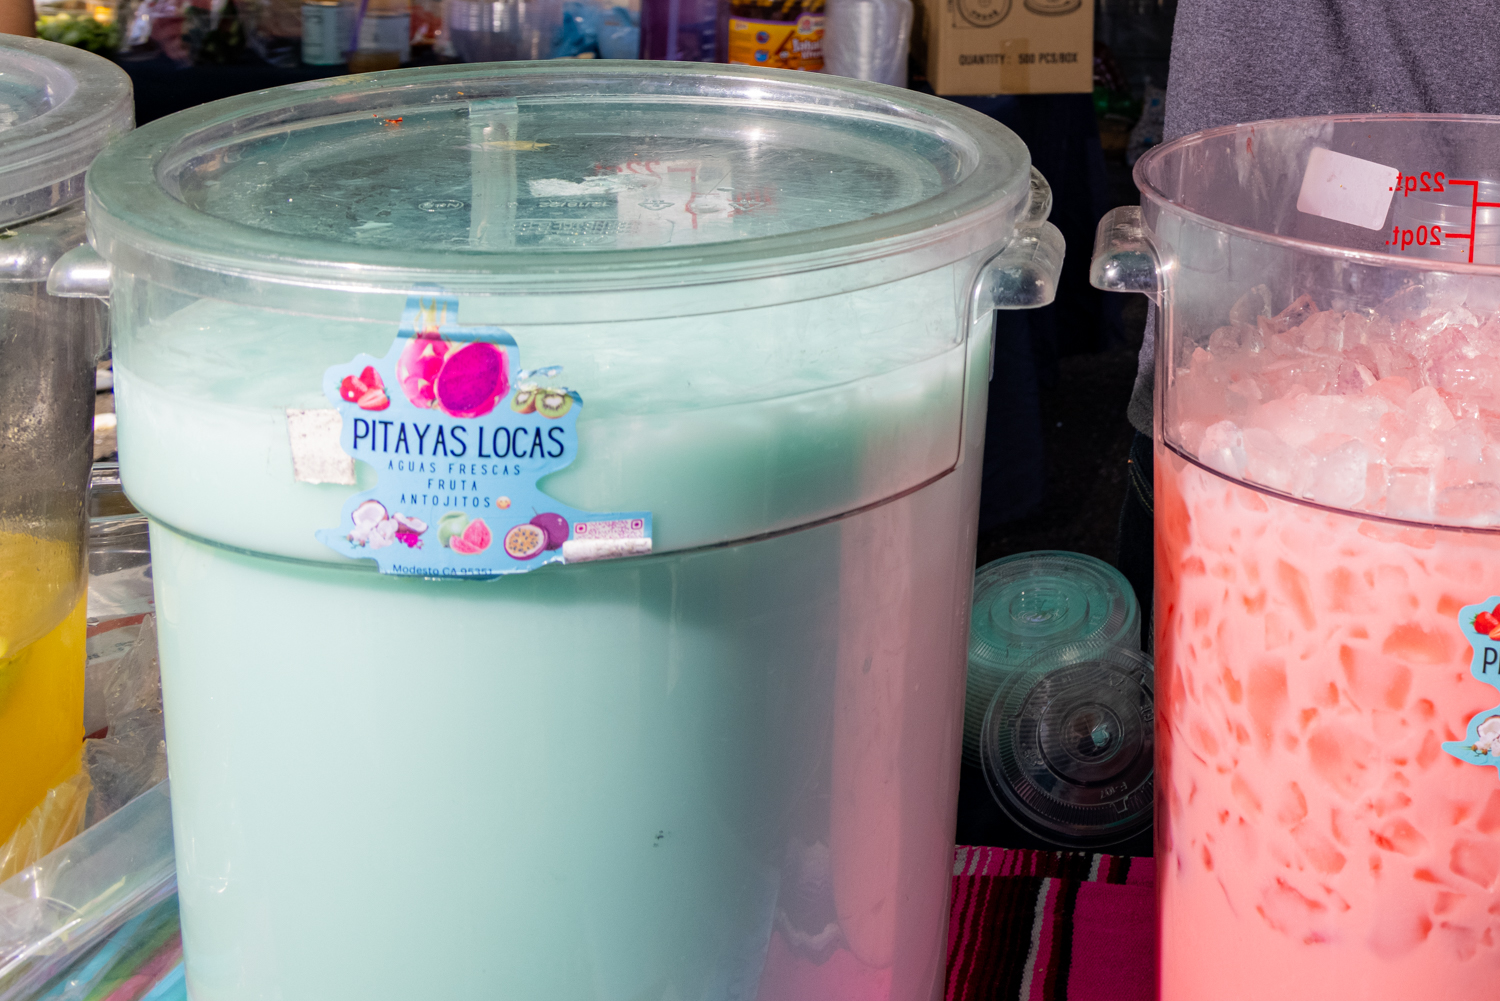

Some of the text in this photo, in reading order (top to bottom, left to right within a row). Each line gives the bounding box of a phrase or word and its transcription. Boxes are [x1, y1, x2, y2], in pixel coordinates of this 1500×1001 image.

[1018, 53, 1036, 65] 500
[352, 417, 565, 459] PITAYAS LOCAS
[388, 459, 521, 476] AGUAS FRESCAS
[428, 478, 478, 491] FRUTA
[400, 493, 491, 508] ANTOJITOS
[392, 564, 439, 576] Modesto
[442, 567, 457, 576] CA
